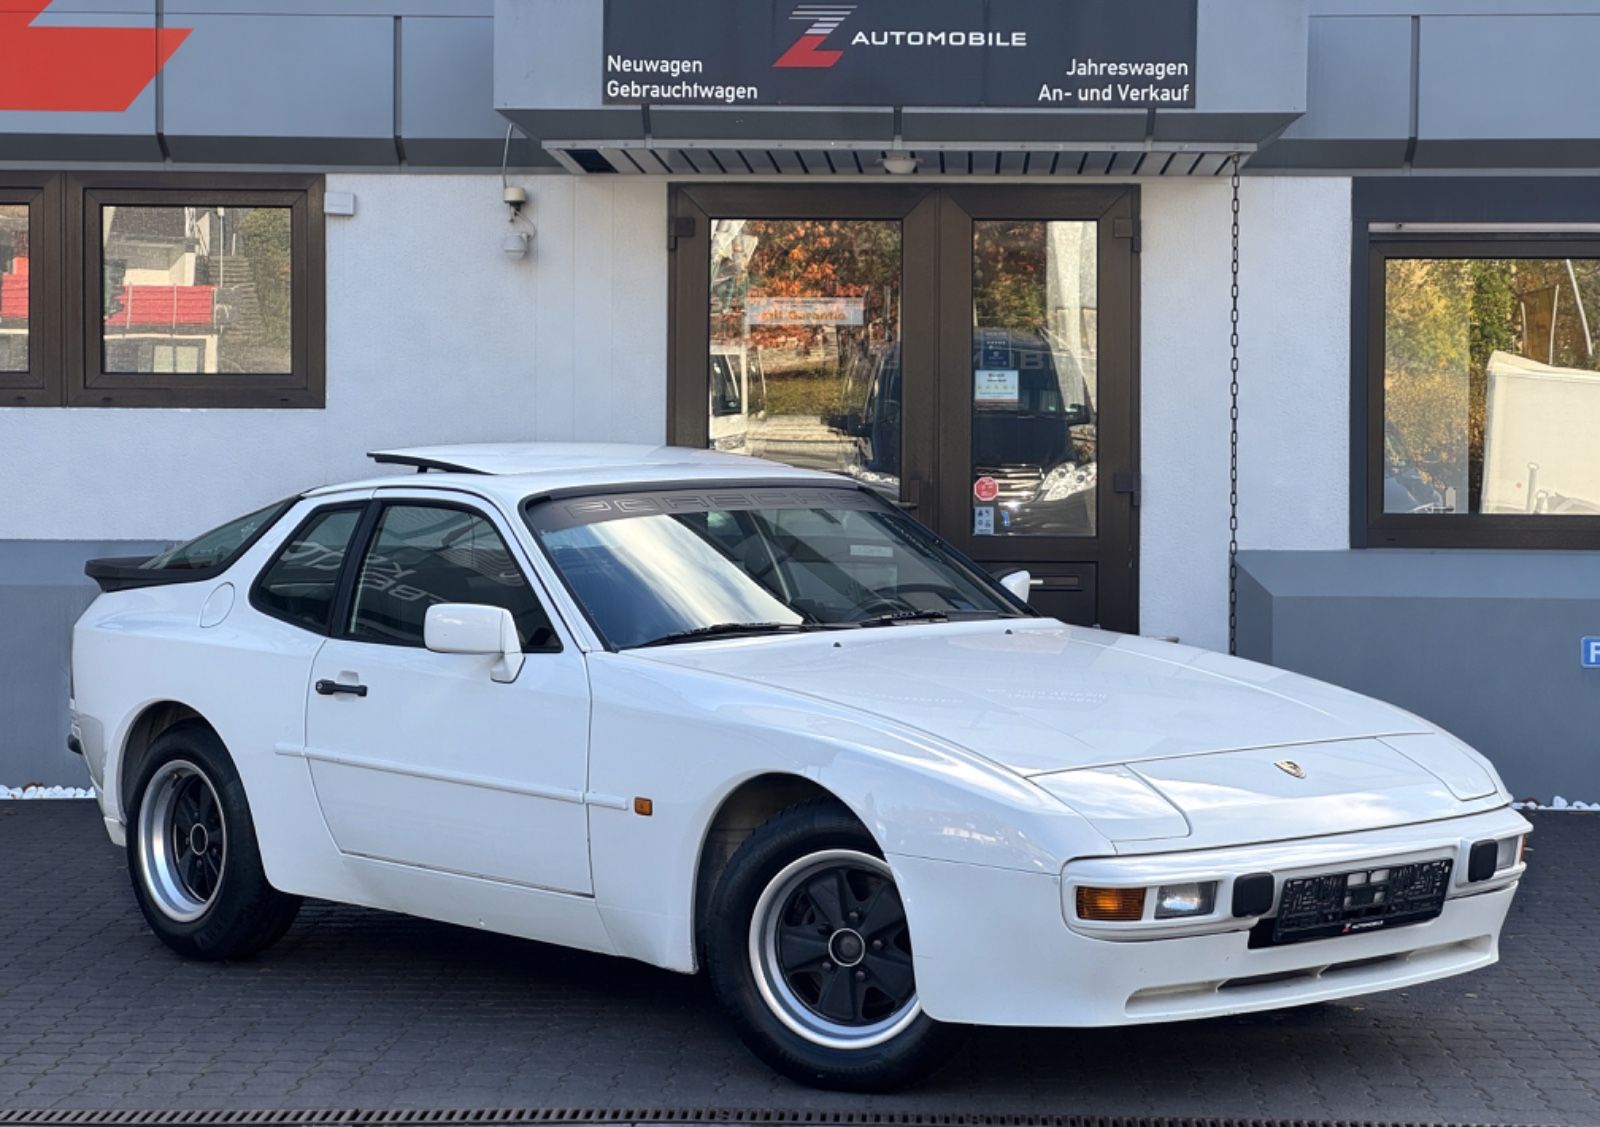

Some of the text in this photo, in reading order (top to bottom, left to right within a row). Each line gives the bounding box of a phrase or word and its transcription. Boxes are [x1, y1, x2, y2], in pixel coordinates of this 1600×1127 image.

[851, 31, 1027, 46] AUTOMOBILE
[607, 55, 703, 77] Neuwagen
[1066, 58, 1188, 80] Jahreswagen
[607, 80, 758, 103] Gebrauchtwagen
[1038, 84, 1189, 101] An- und Verkauf
